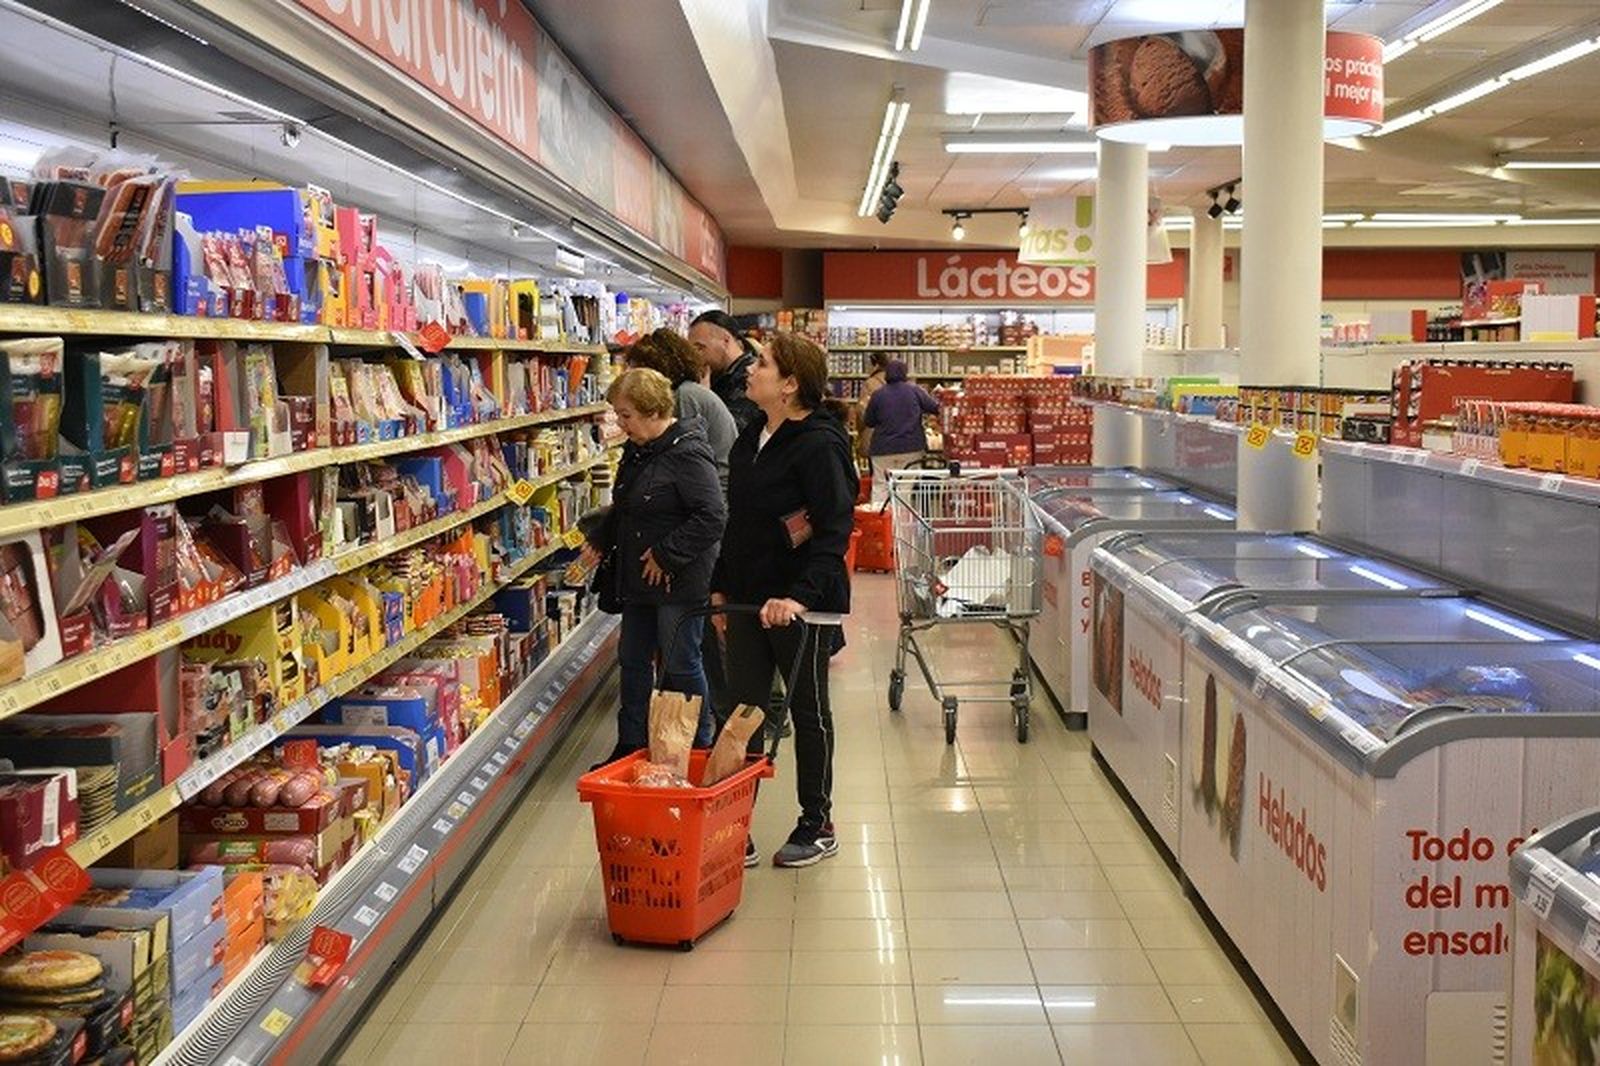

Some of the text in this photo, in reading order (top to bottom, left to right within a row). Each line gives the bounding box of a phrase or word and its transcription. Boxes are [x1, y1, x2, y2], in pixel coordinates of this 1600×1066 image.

[1323, 57, 1343, 73] os
[1334, 80, 1370, 104] mejor
[916, 254, 1092, 298] Lácteos
[1259, 771, 1328, 893] Helados
[1405, 828, 1494, 862] Todo
[1405, 875, 1462, 909] del
[1475, 884, 1510, 909] m
[1403, 921, 1510, 956] ensal
